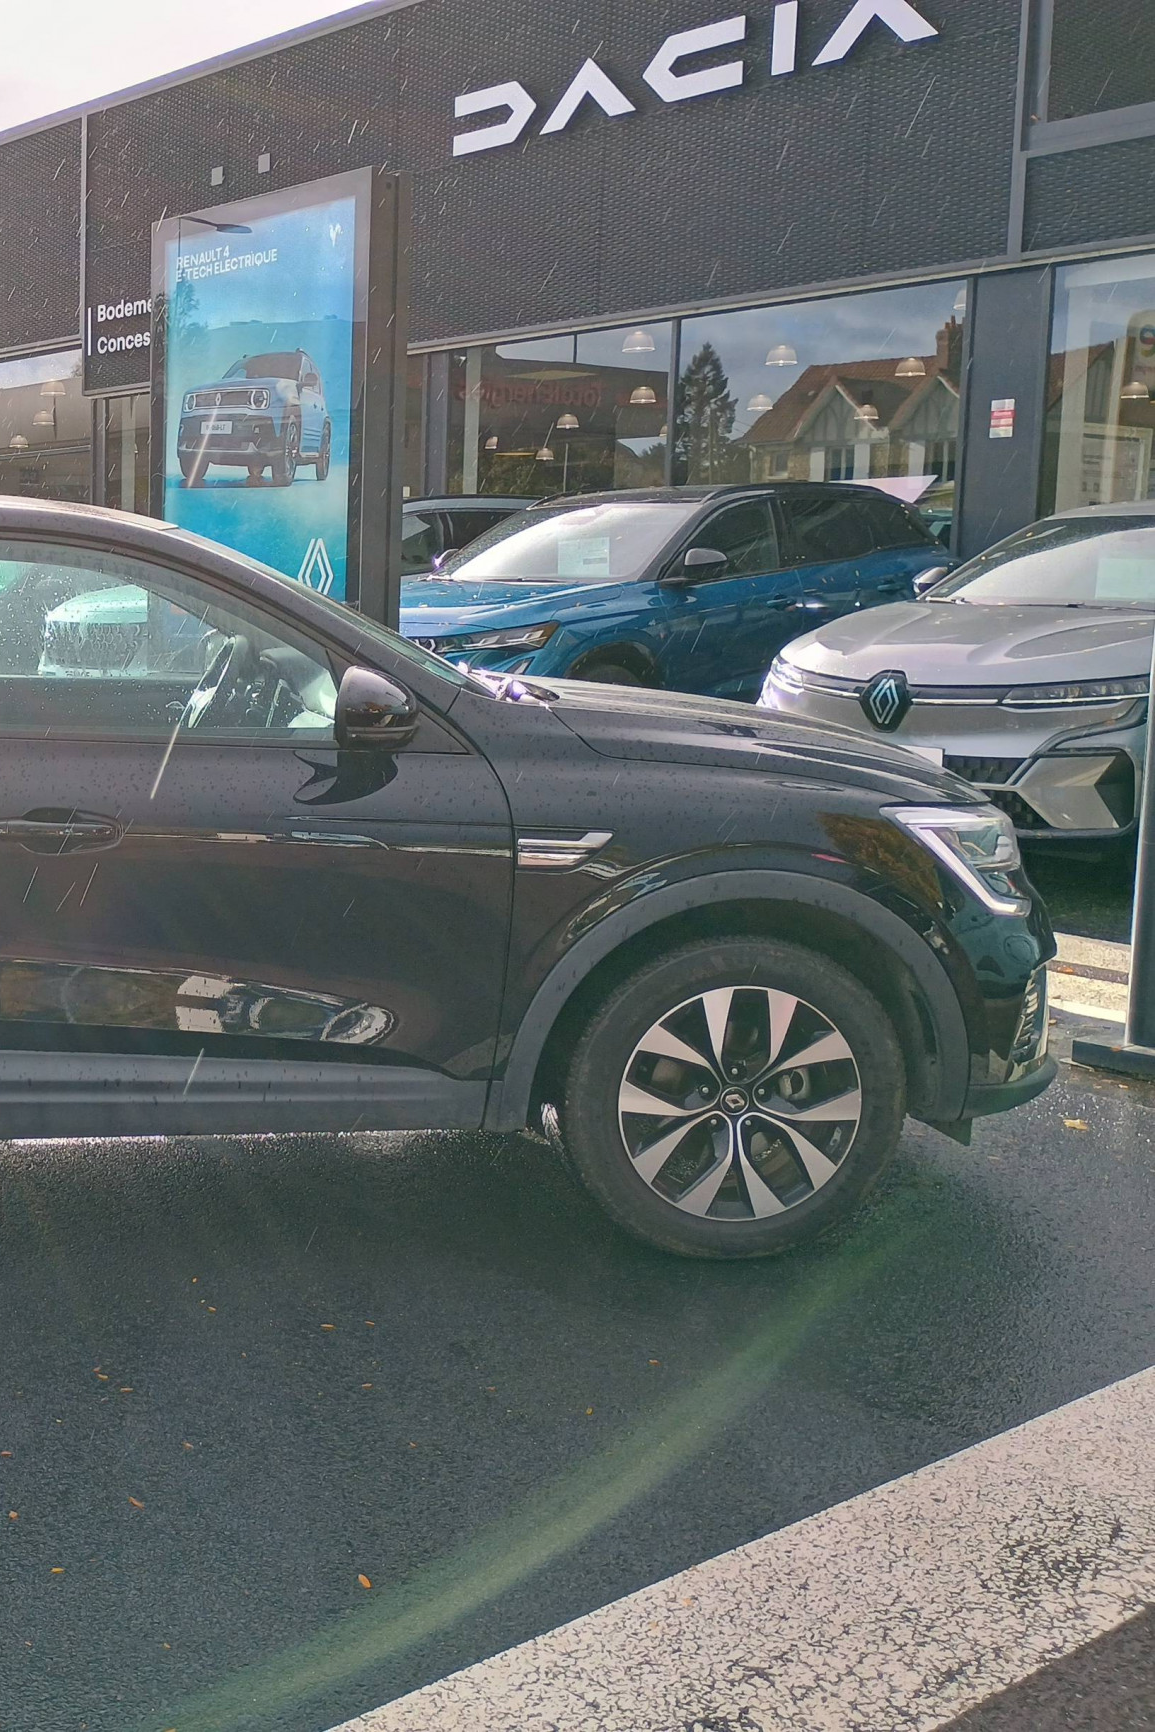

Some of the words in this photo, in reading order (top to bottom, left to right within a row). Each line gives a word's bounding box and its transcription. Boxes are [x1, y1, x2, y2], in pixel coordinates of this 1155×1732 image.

[452, 0, 939, 157] DACIA
[176, 263, 213, 283] E-TECH
[214, 248, 278, 275] ELECTRIQUE
[177, 247, 222, 270] RENAULT
[223, 245, 230, 258] 4
